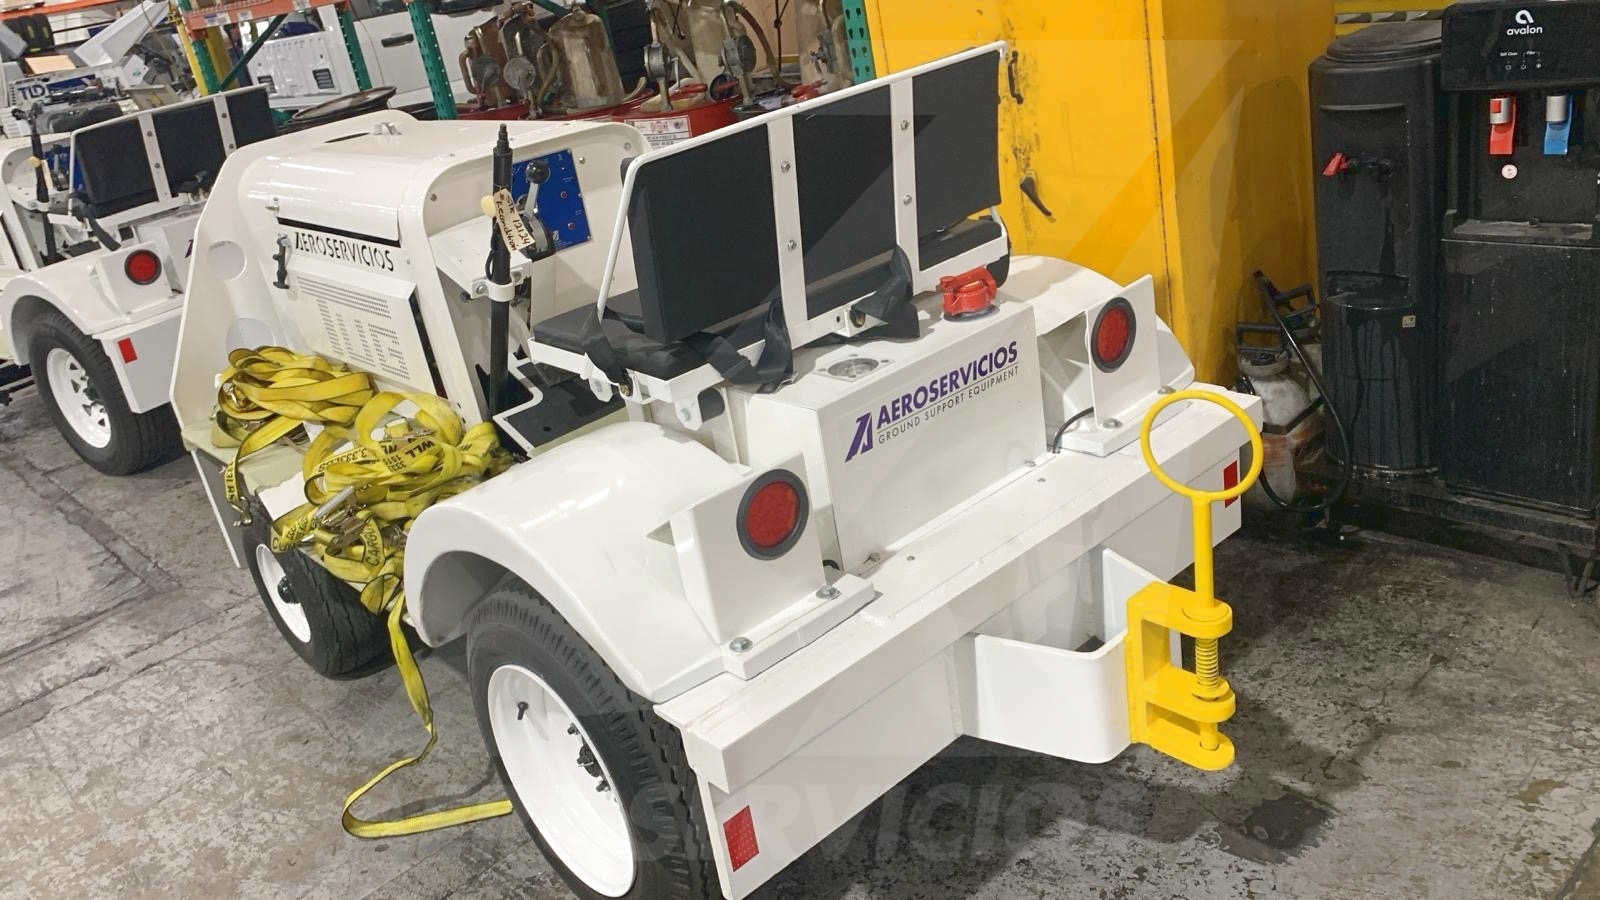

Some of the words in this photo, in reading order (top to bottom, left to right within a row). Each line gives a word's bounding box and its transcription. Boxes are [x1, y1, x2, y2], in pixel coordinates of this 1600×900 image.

[1506, 25, 1543, 36] avalon
[17, 84, 46, 100] TLD
[876, 340, 1018, 430] AEROSERVICIOS
[878, 416, 920, 444] GROUND
[925, 393, 964, 421] SUPPORT
[968, 366, 1019, 398] EQUIPMENT
